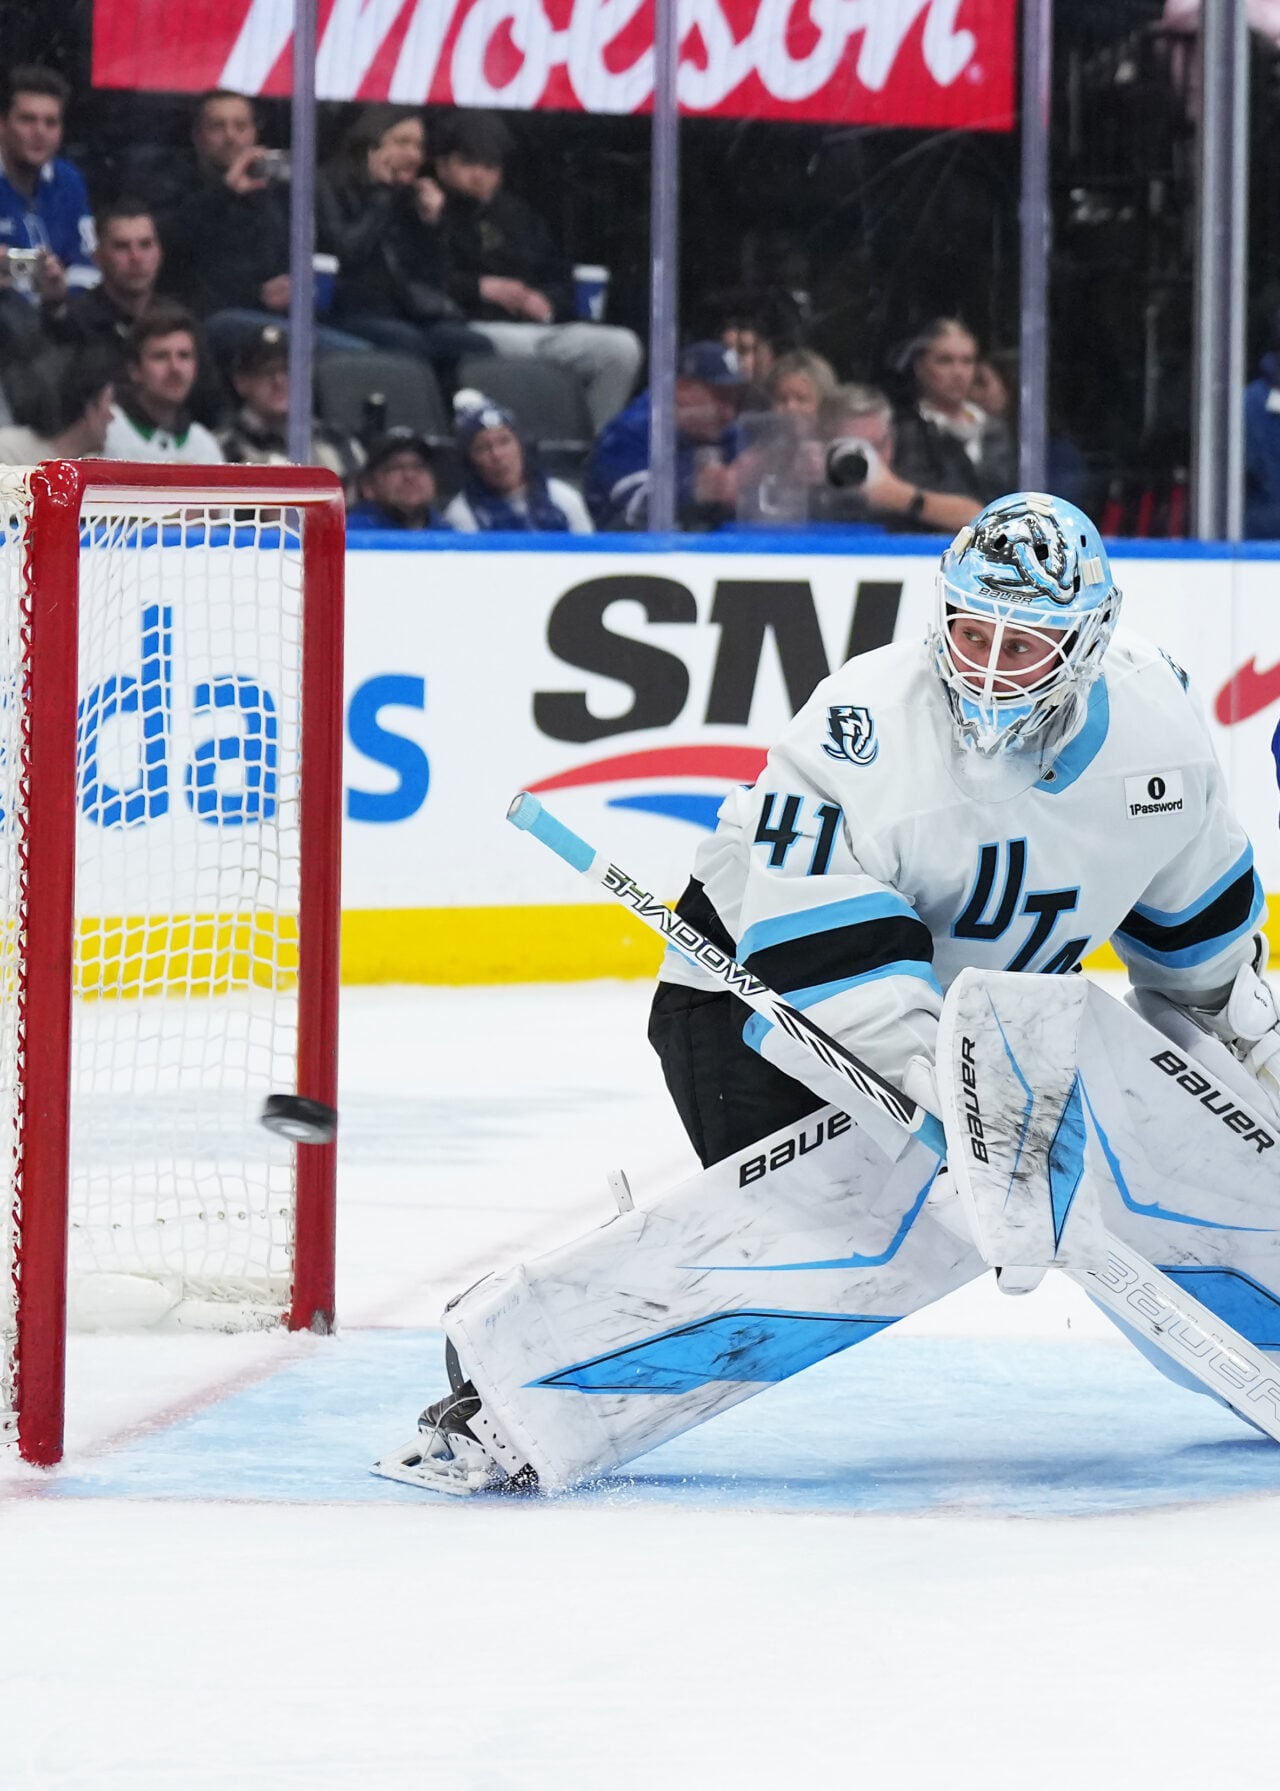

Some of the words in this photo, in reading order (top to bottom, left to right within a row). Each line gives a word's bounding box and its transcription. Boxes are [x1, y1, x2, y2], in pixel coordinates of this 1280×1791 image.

[978, 587, 1034, 605] BAUER
[532, 574, 904, 744] SN
[77, 600, 431, 829] das
[752, 791, 842, 877] 41
[1129, 798, 1183, 816] 1Password
[601, 863, 769, 996] SHADOW
[739, 1110, 858, 1188] BAUE
[959, 1036, 991, 1165] BAUER
[1150, 1049, 1276, 1155] BAUER
